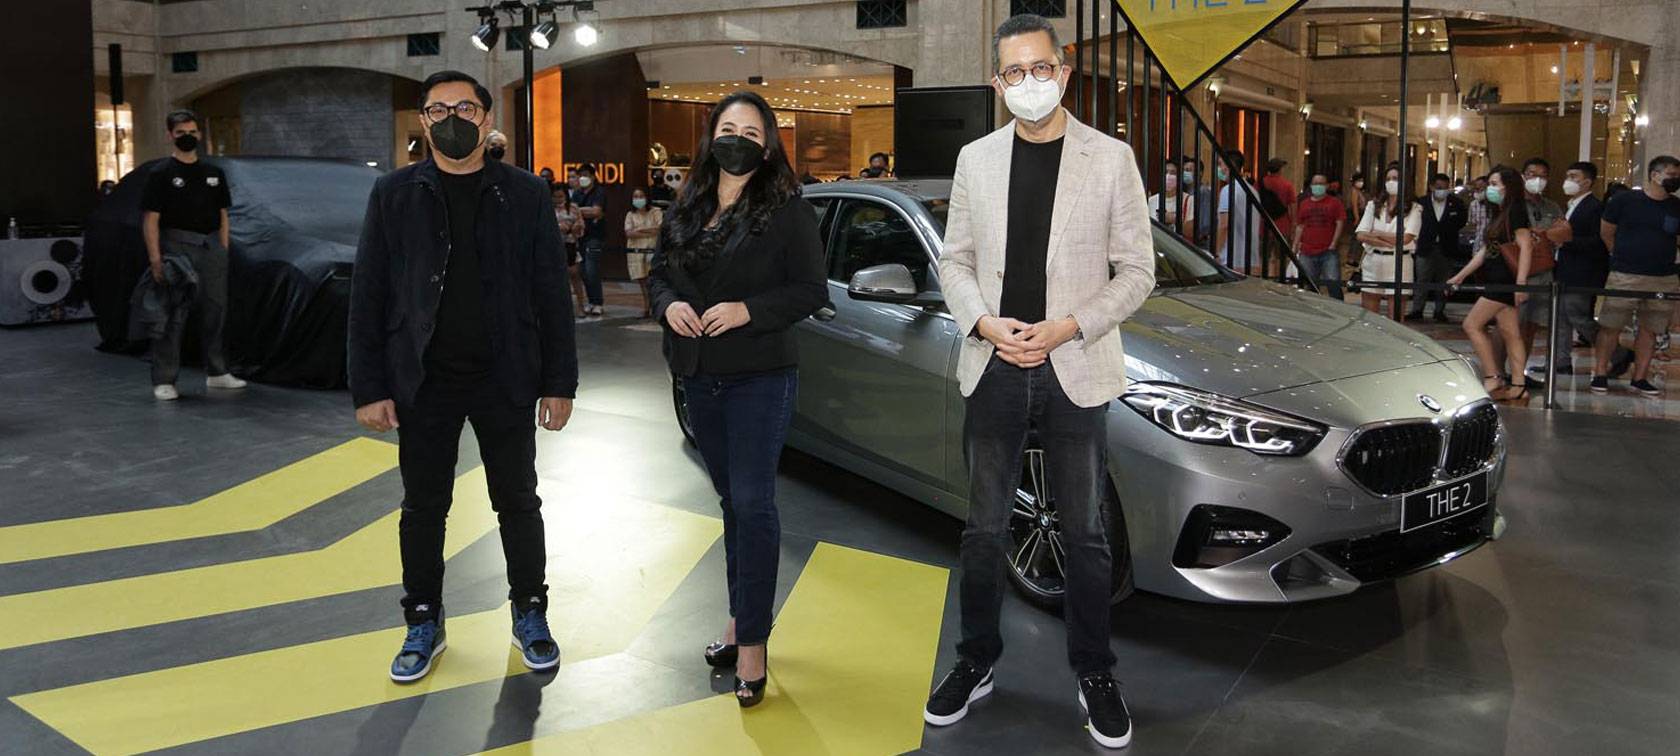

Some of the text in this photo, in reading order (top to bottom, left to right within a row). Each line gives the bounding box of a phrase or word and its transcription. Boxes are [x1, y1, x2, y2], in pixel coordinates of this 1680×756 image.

[564, 163, 624, 184] FNDI
[1426, 482, 1471, 518] THE 2
